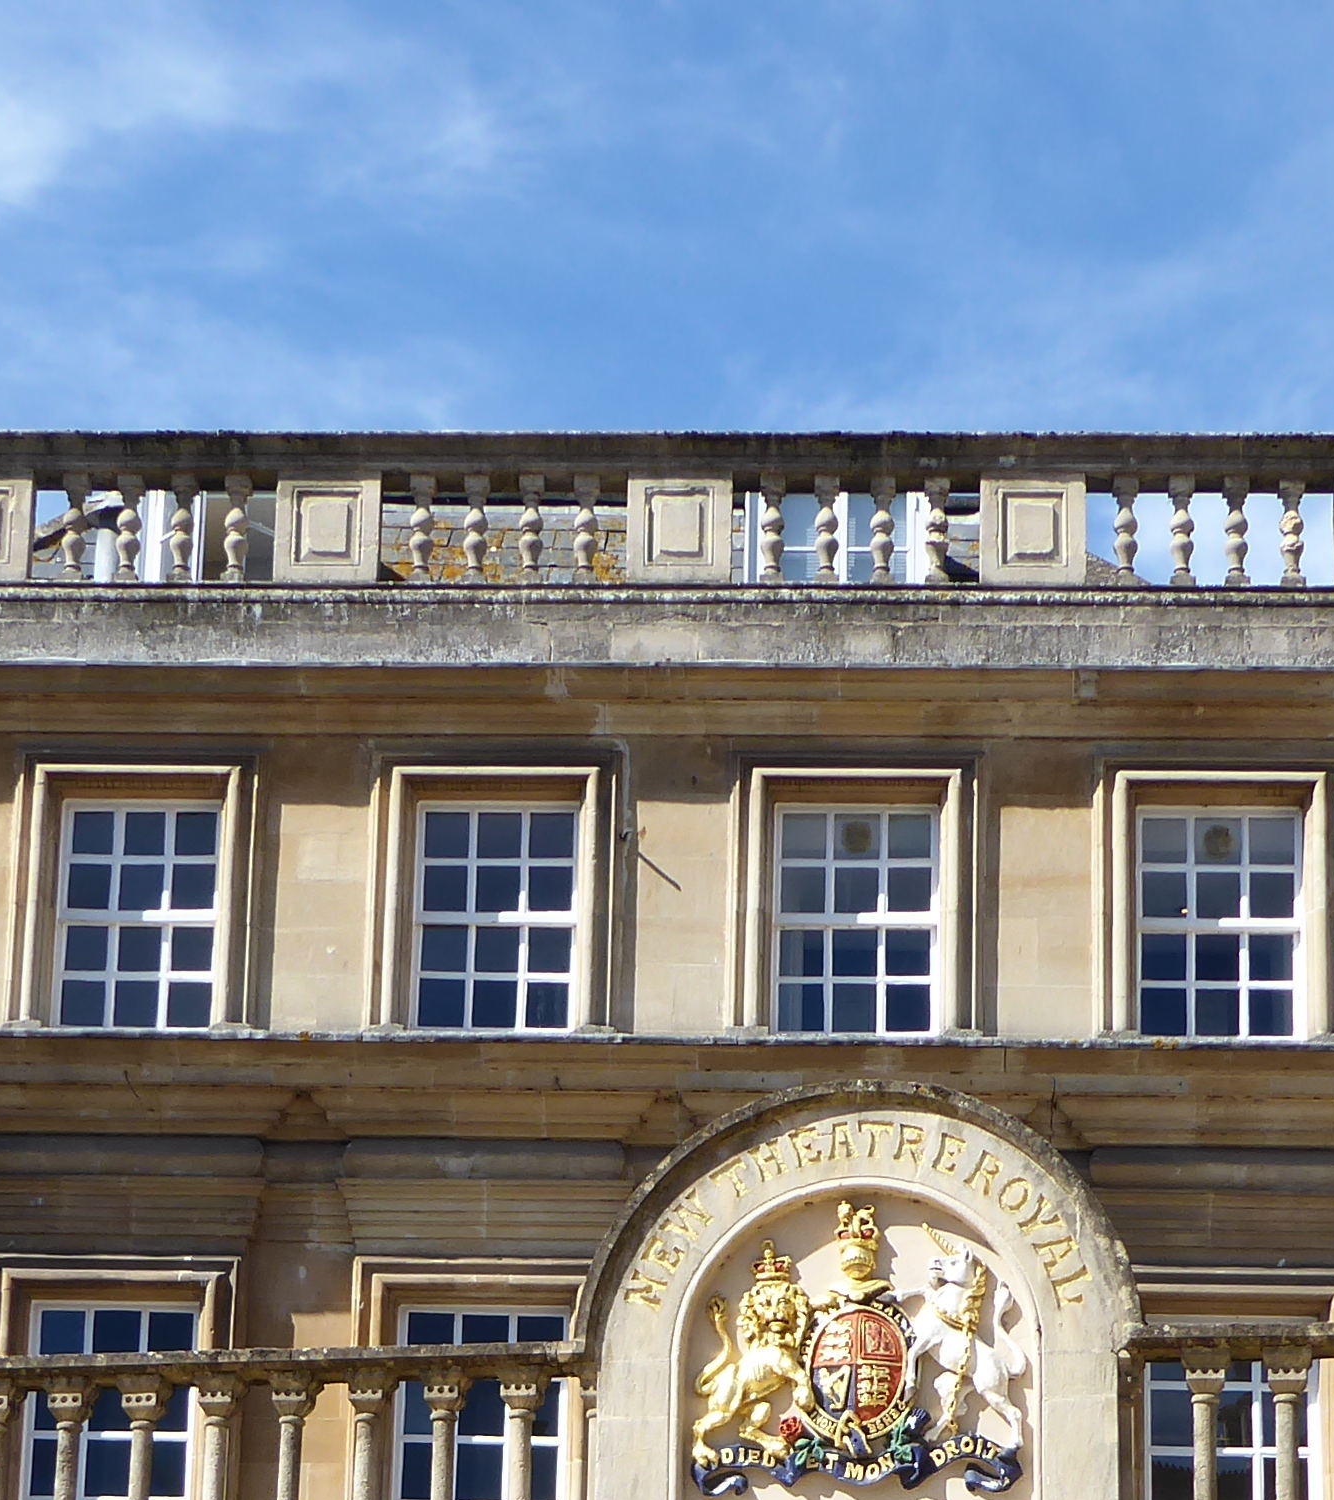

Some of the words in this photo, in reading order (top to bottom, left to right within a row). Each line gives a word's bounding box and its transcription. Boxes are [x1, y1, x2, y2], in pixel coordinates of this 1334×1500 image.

[624, 1188, 715, 1312] NEW
[709, 1120, 968, 1198] THEATRE
[963, 1150, 1093, 1310] ROYAL
[844, 1454, 896, 1481] MON
[929, 1436, 1000, 1469] DROIT
